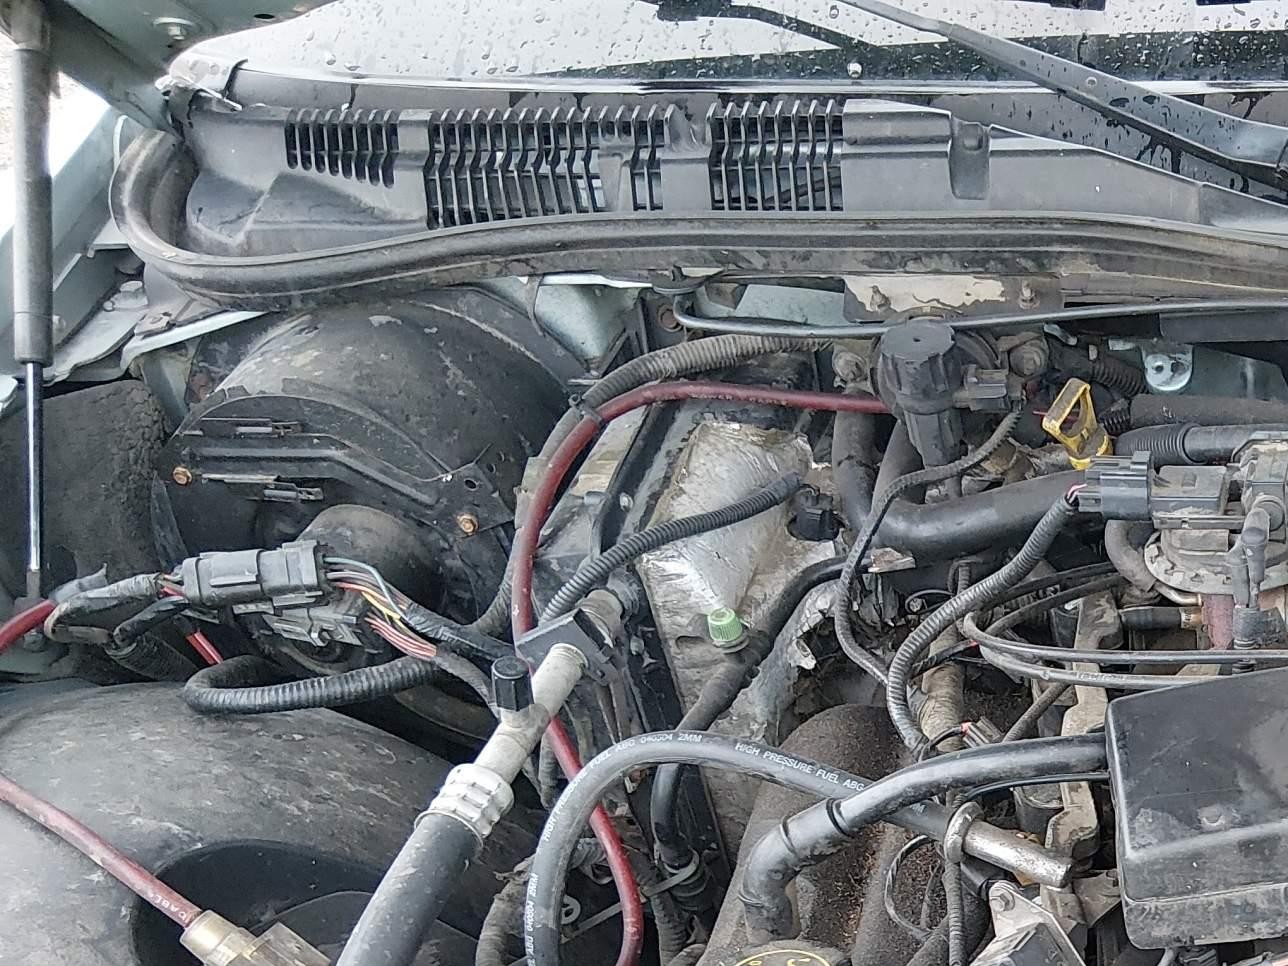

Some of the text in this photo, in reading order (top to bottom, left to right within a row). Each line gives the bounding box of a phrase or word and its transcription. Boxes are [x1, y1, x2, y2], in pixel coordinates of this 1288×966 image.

[590, 752, 612, 769] FUEL
[735, 742, 761, 757] HIGH
[762, 751, 814, 774] PRESSURE
[815, 768, 840, 784] FUEL
